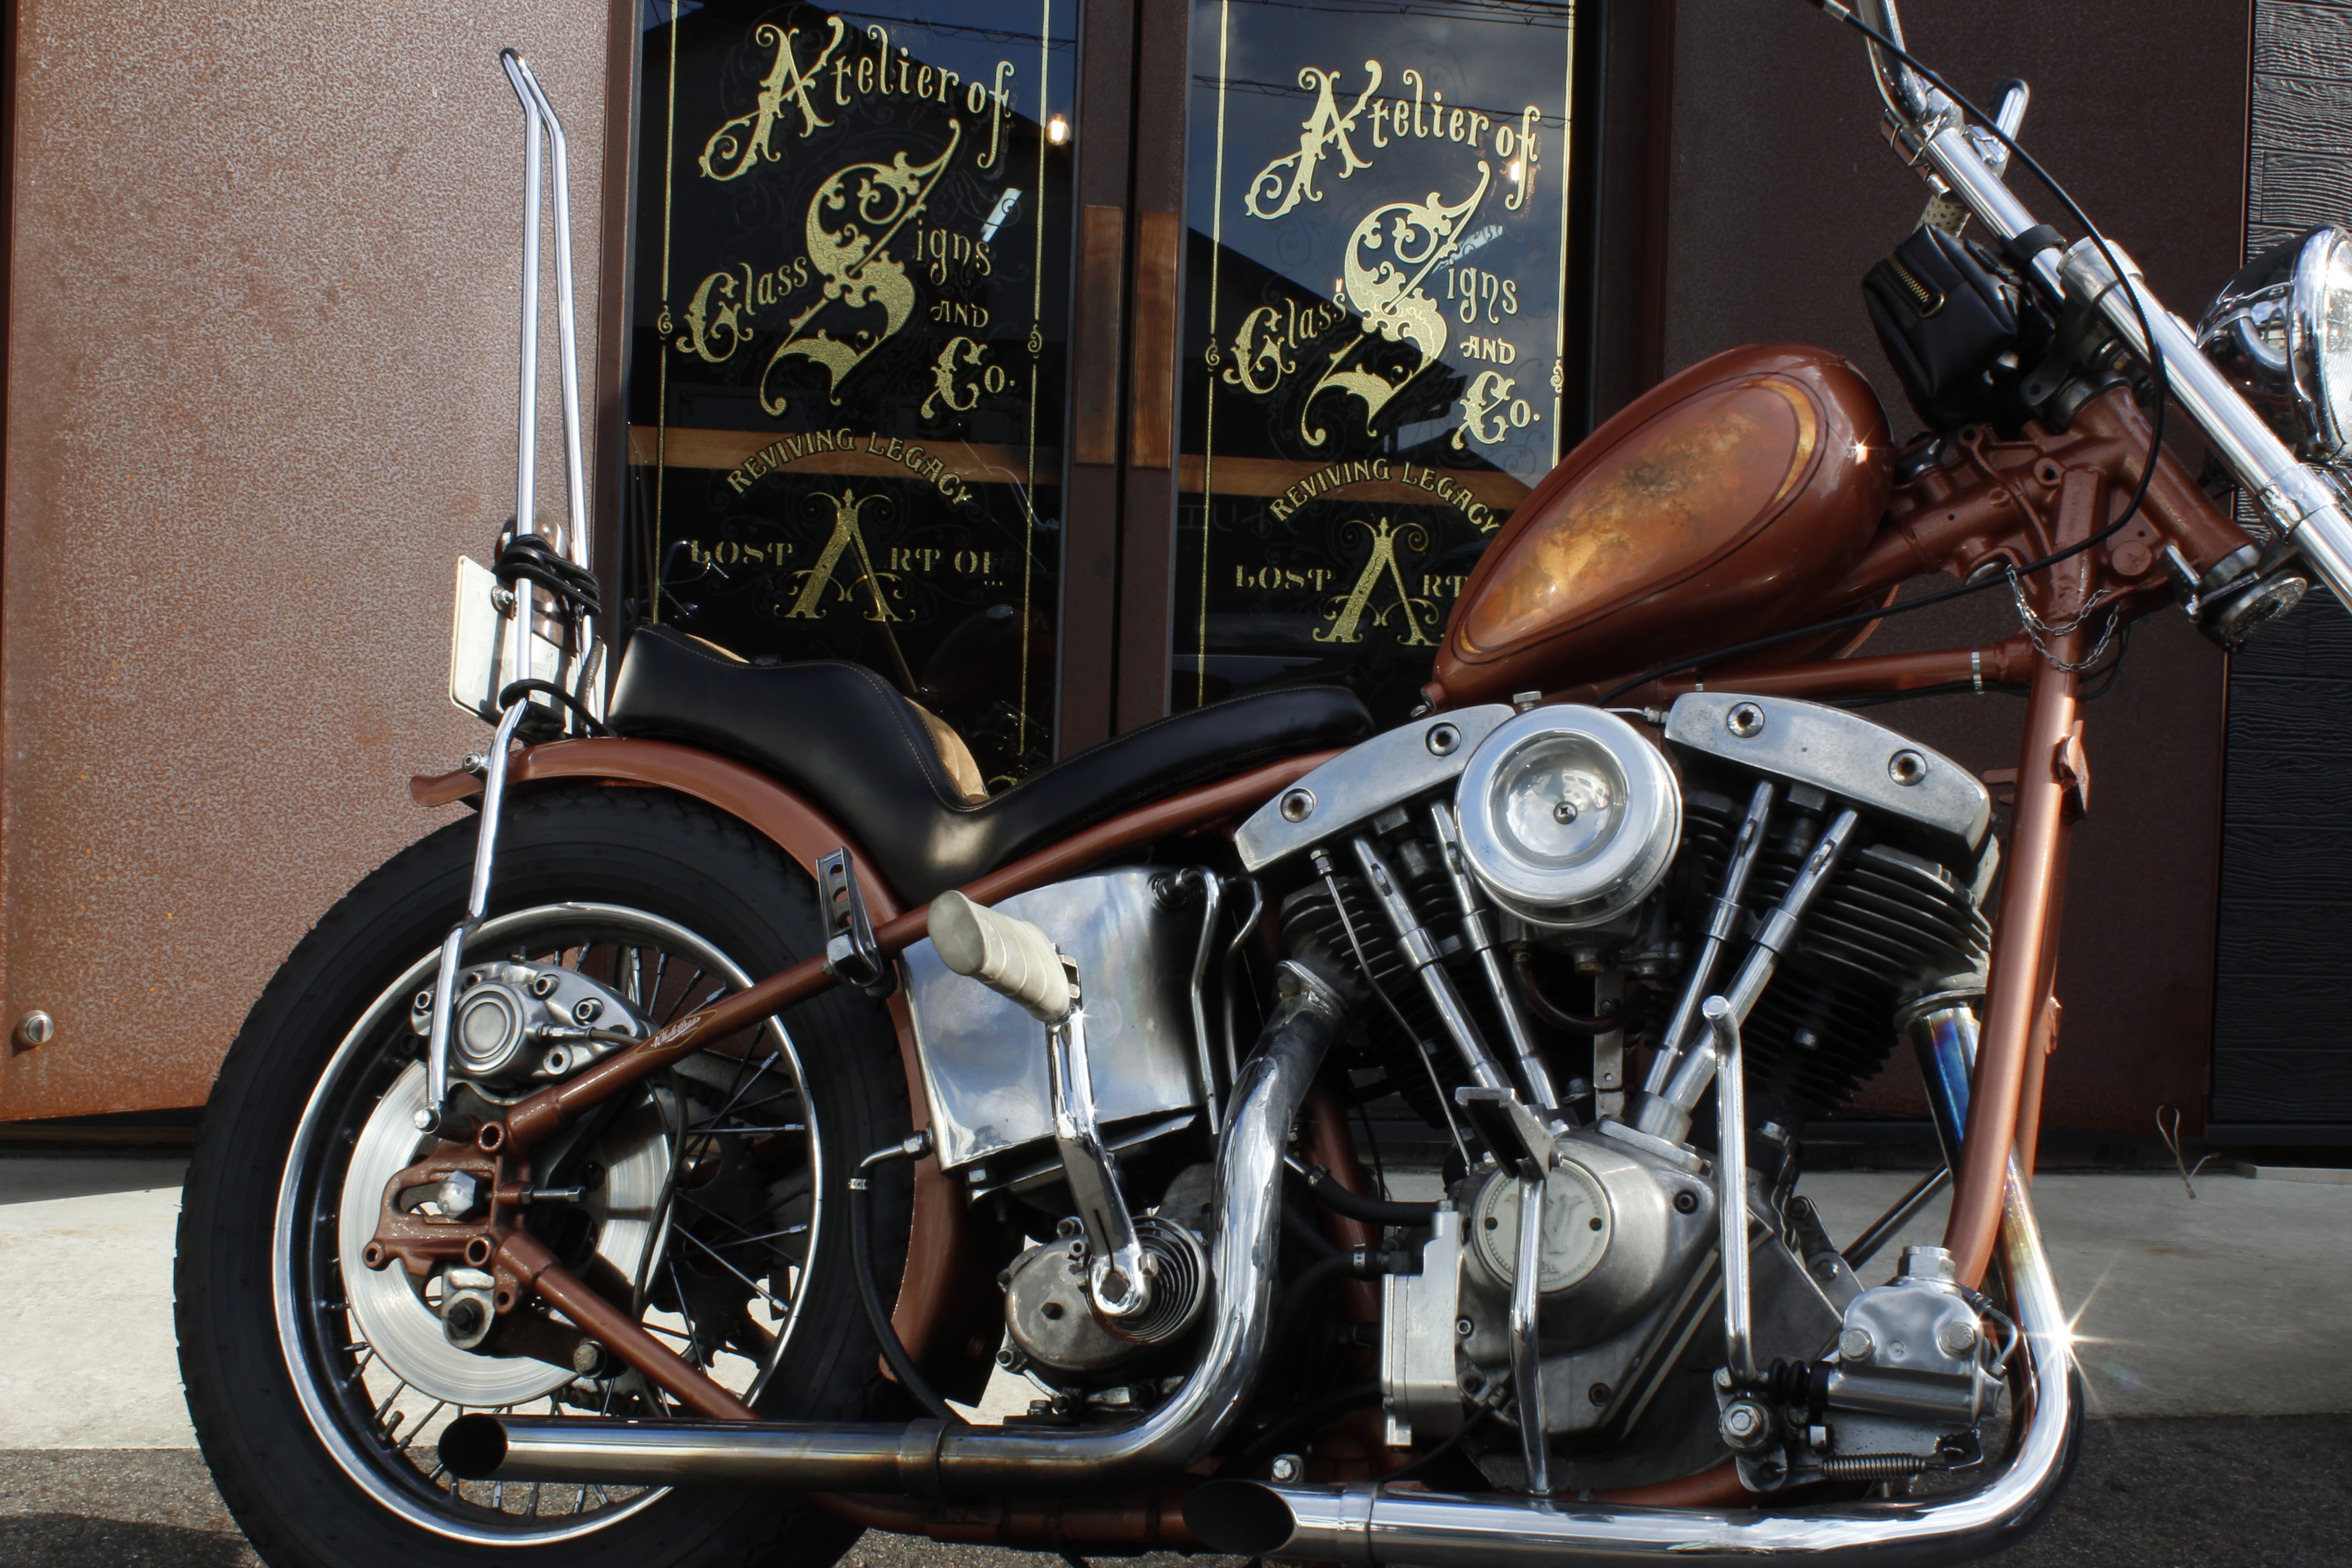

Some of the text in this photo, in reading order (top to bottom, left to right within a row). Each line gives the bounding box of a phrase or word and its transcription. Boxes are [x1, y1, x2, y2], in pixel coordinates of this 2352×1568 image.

[699, 16, 1016, 181] Atelier of
[1244, 59, 1541, 220] Atelier of
[676, 119, 991, 417] Glass Signs
[1224, 160, 1518, 446] Glass Signs
[930, 300, 988, 328] AND
[1461, 336, 1516, 364] AND
[921, 336, 1016, 419] Co.
[1451, 371, 1541, 450] Co.
[726, 427, 972, 507] REVIVING LEGACY
[1269, 458, 1501, 535] REVIVING LEGACY
[691, 540, 794, 566] LOST
[1235, 565, 1333, 590] LOST
